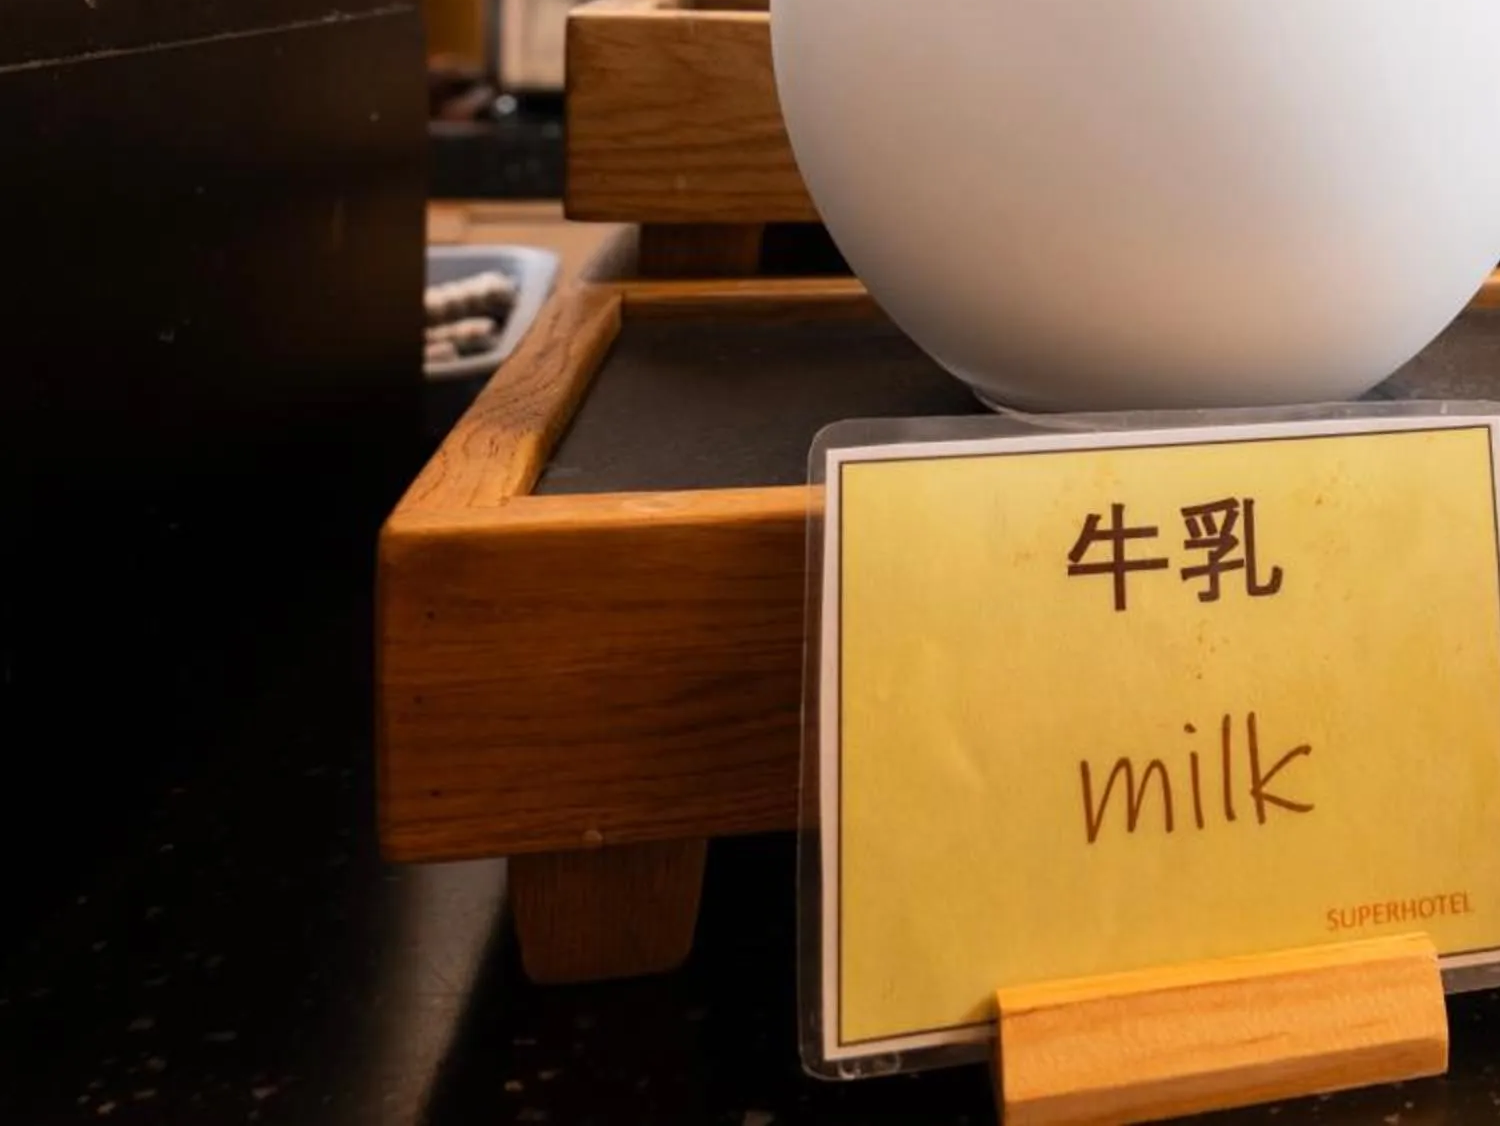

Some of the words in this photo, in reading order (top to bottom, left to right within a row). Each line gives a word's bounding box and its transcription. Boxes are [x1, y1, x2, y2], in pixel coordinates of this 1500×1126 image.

[1067, 497, 1284, 612] 牛乳
[1079, 710, 1315, 845] milk
[1325, 889, 1475, 933] SUPERHOTEL
